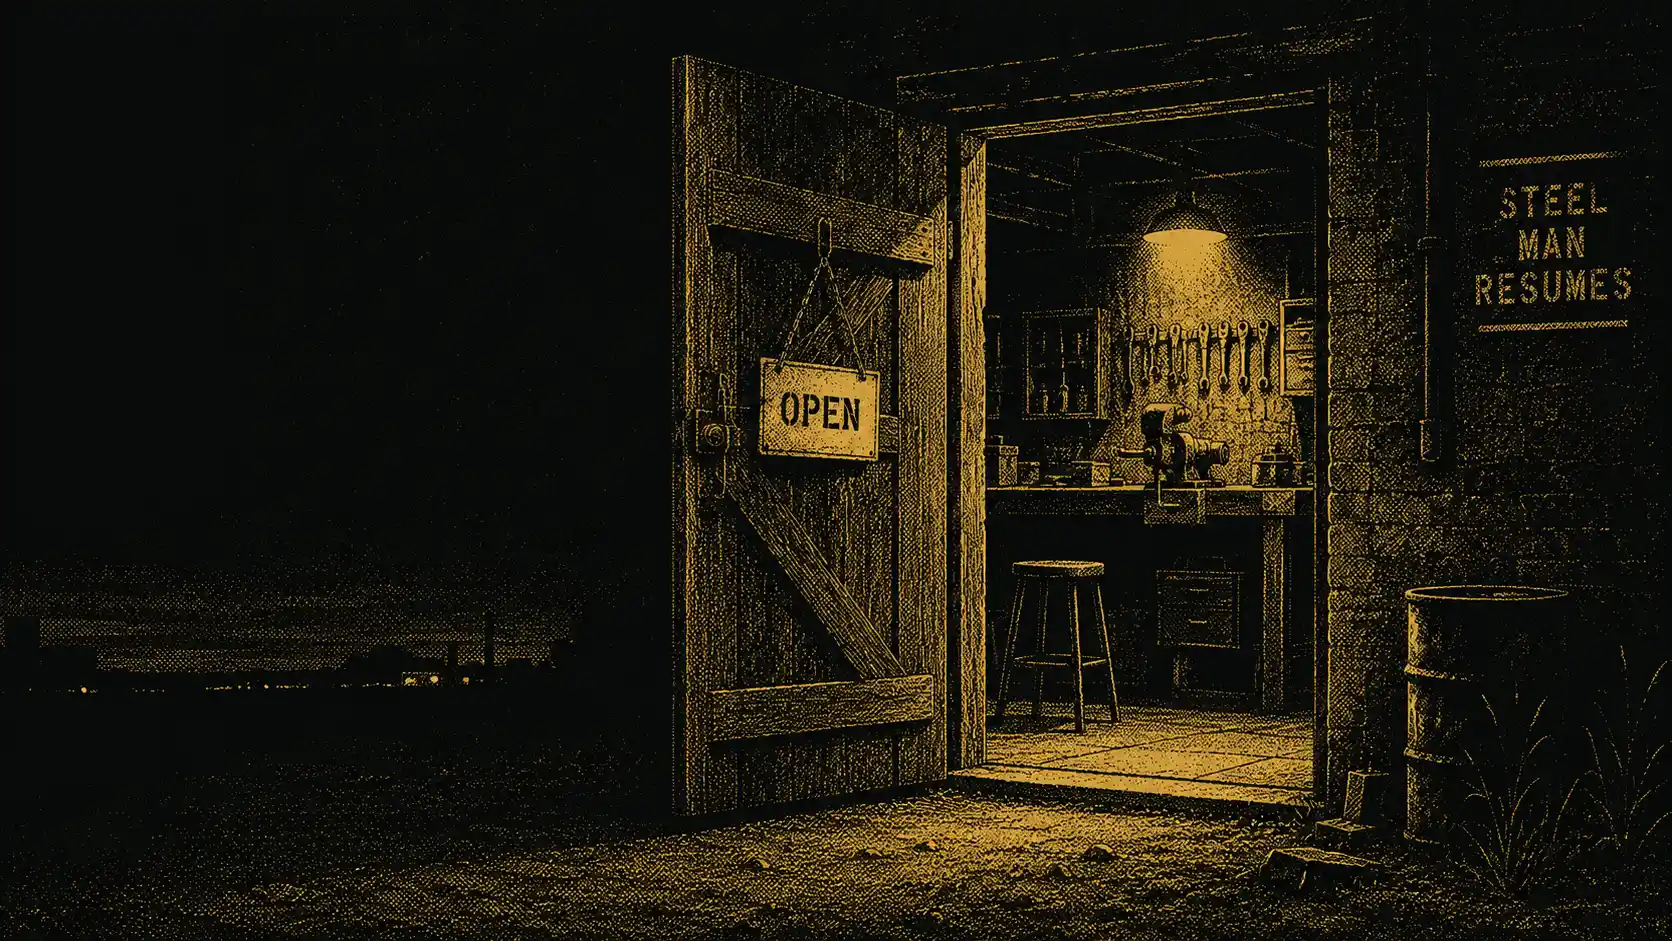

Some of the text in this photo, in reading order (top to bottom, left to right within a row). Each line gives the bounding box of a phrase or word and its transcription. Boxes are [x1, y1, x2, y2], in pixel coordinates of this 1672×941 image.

[1500, 181, 1607, 219] STEEL
[1518, 226, 1585, 260] MAN
[1475, 267, 1632, 305] RESUMES
[781, 392, 860, 431] OPEN
